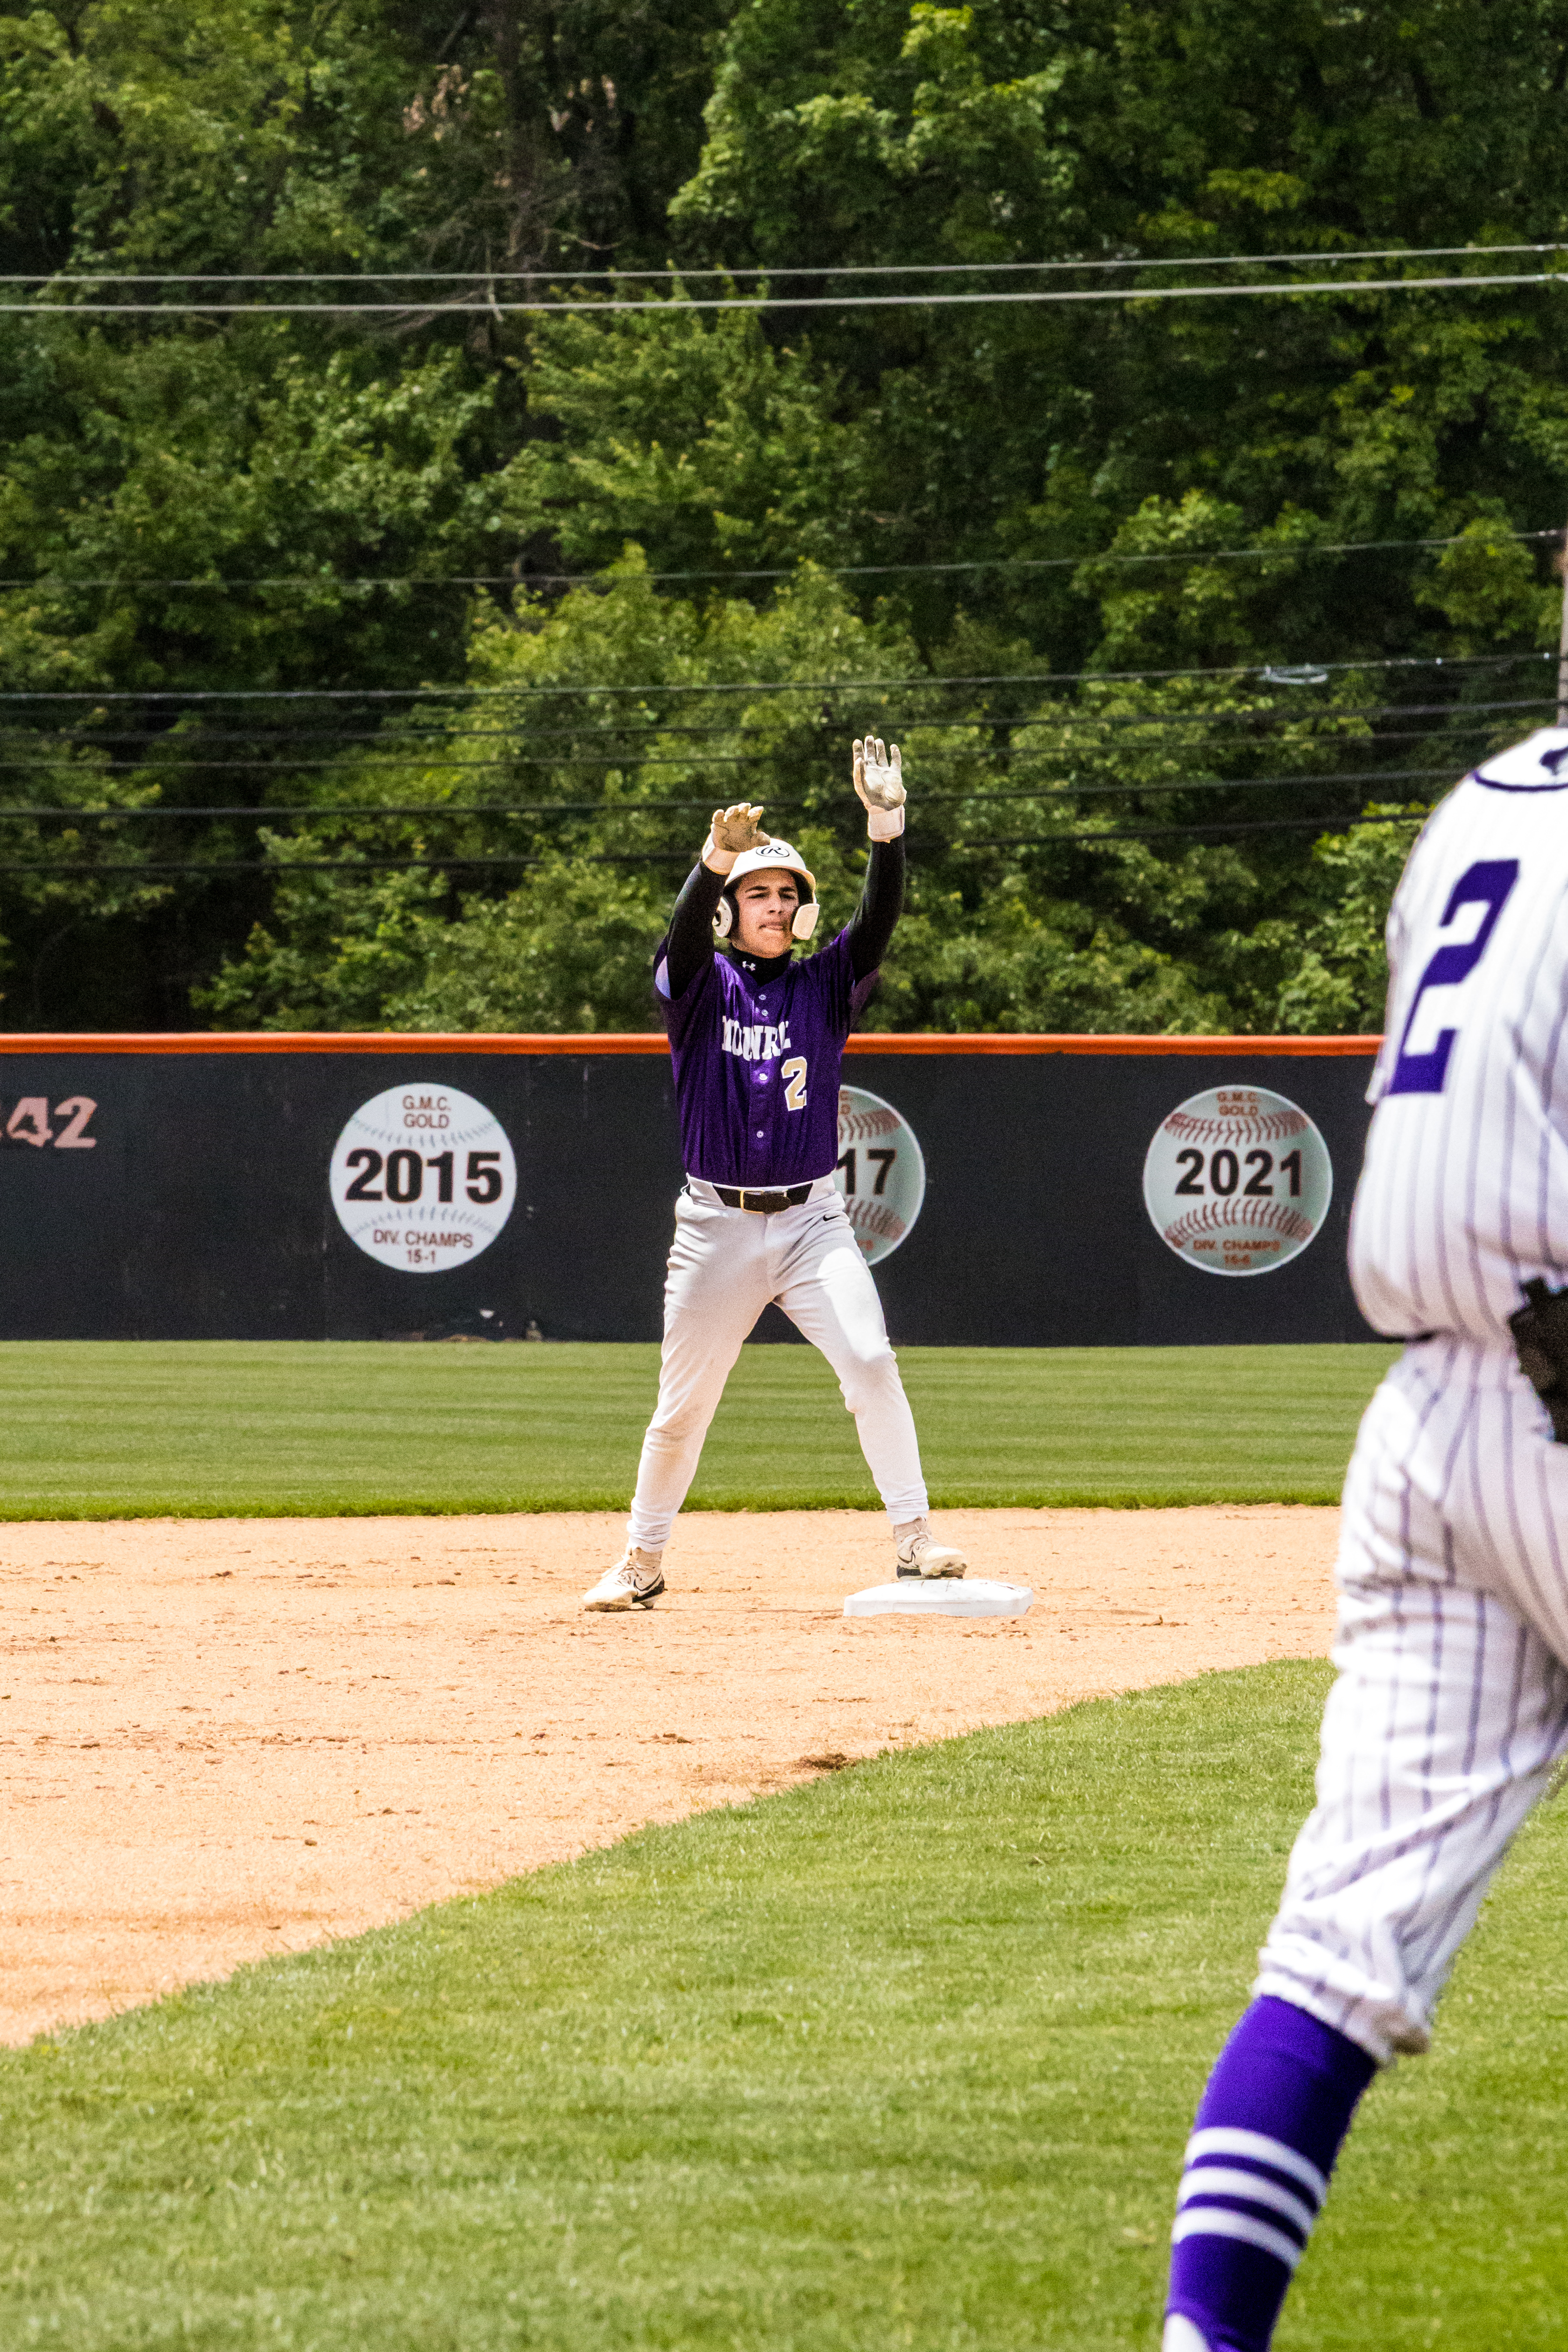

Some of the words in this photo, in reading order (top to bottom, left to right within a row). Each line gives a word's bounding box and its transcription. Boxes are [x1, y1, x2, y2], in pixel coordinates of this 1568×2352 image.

[1389, 858, 1520, 1094] 2
[403, 1095, 451, 1110] G.M.C.
[781, 1056, 807, 1111] 2
[0, 1095, 98, 1148] 42
[404, 1114, 450, 1128] GOLD
[1218, 1105, 1258, 1116] GOLD
[345, 1148, 503, 1205] 2015
[836, 1148, 897, 1195] 17
[1175, 1148, 1302, 1197] 2021
[373, 1229, 400, 1245] DIV.
[404, 1230, 474, 1248] CHAMPS
